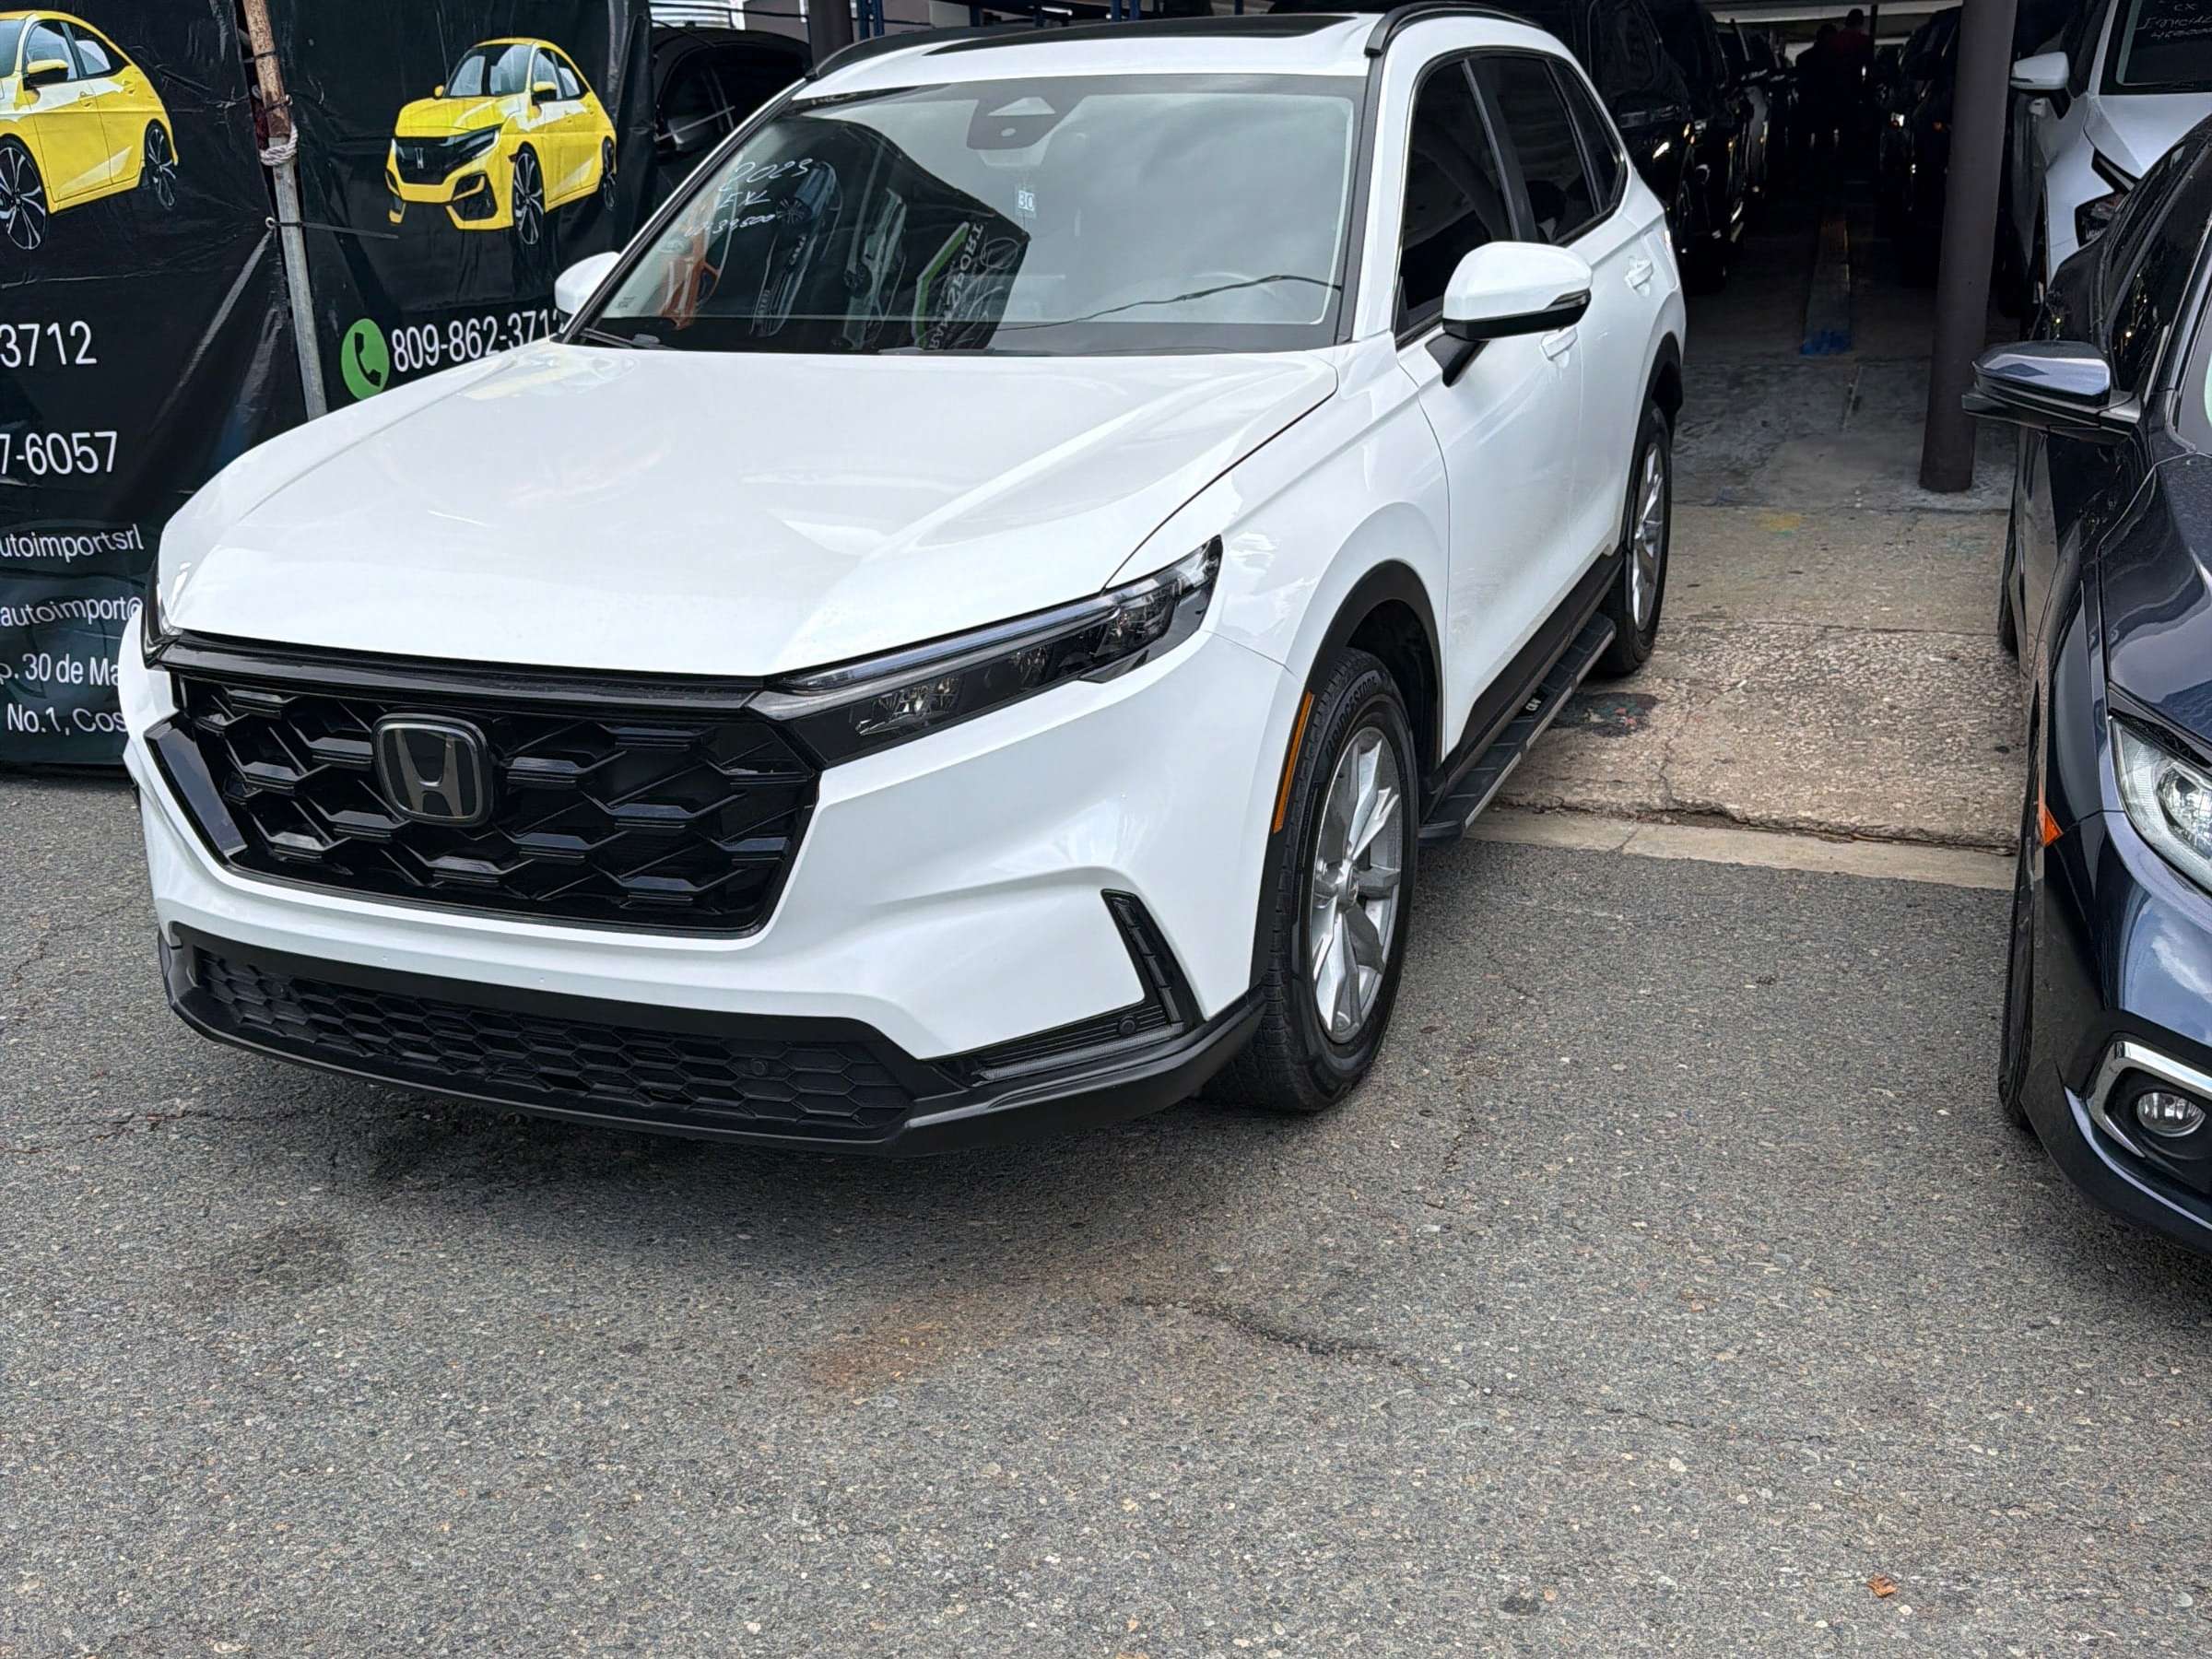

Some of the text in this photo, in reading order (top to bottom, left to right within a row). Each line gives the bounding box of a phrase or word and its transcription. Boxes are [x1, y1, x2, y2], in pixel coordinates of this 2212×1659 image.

[0, 320, 98, 369] 3712
[21, 653, 52, 682] 30
[55, 653, 84, 685] de
